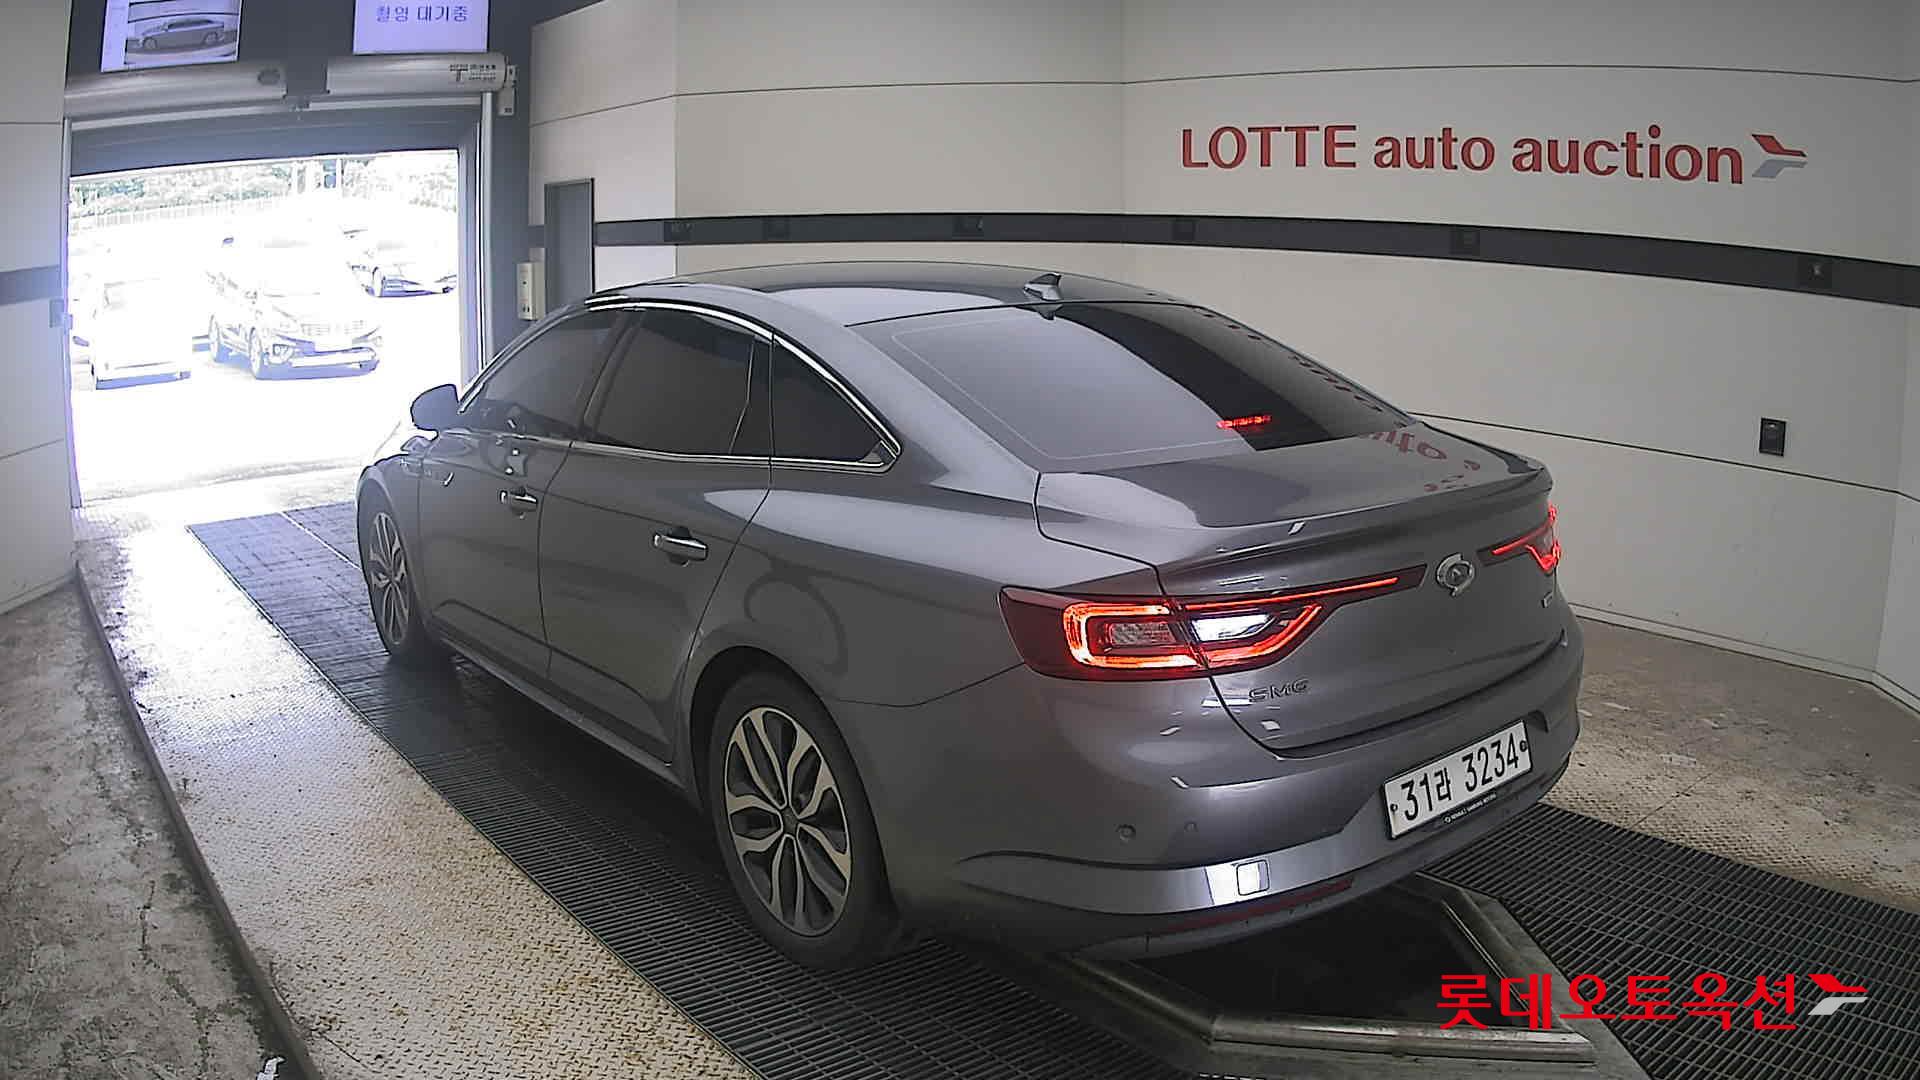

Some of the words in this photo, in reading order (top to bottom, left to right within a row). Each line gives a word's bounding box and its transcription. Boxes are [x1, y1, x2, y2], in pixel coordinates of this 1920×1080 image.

[416, 4, 468, 22] 대기중
[1181, 124, 1357, 169] LOTTE
[1373, 126, 1495, 172] auto
[1511, 124, 1743, 185] auction
[1400, 767, 1452, 821] 31라
[1461, 732, 1519, 792] 3234
